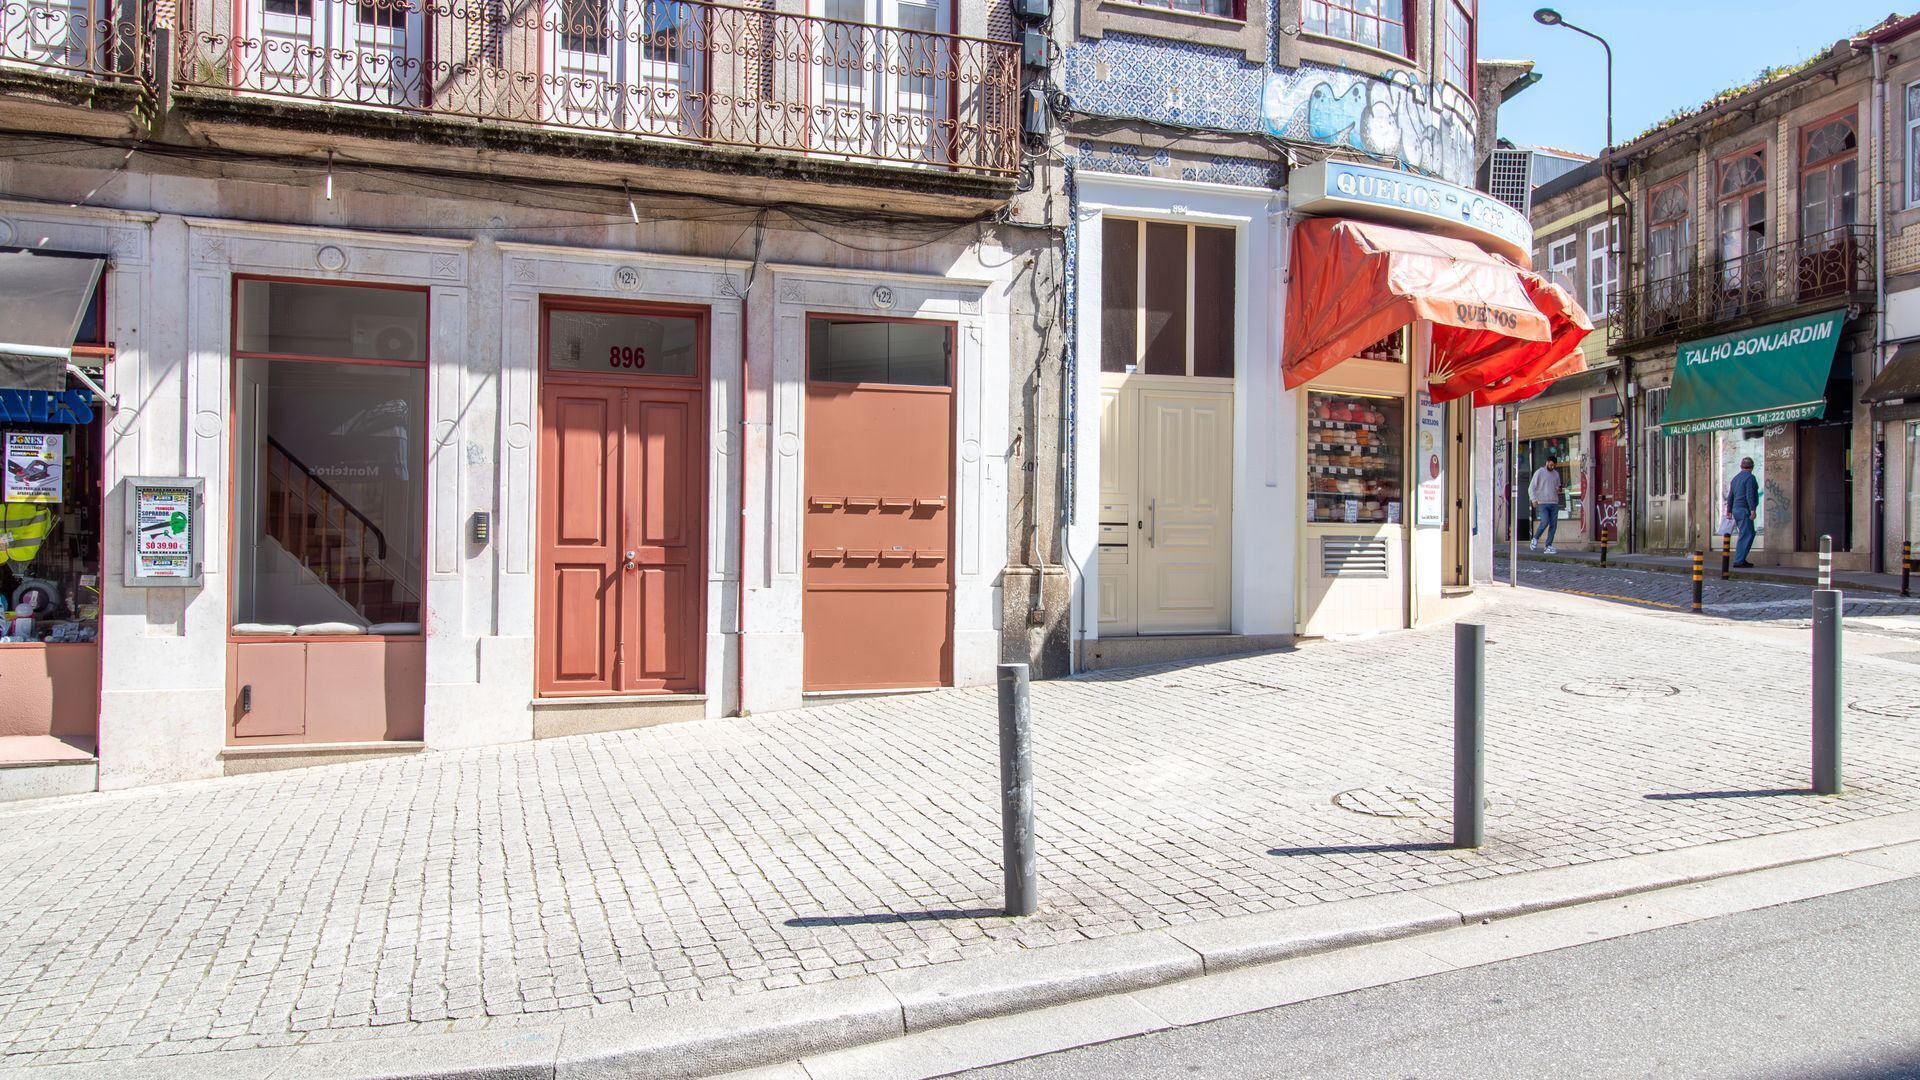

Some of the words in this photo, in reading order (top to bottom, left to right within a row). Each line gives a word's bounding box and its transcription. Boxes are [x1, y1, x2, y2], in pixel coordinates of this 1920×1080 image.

[1337, 172, 1441, 210] QUEIJOS
[1172, 204, 1188, 214] 894
[875, 290, 892, 303] 422
[1457, 304, 1517, 329] QUEIJOS
[1685, 342, 1731, 366] TALHO
[1734, 320, 1833, 356] BONJARDIM
[610, 346, 646, 368] 896
[1671, 424, 1691, 435] TALHO
[1786, 408, 1800, 419] 003
